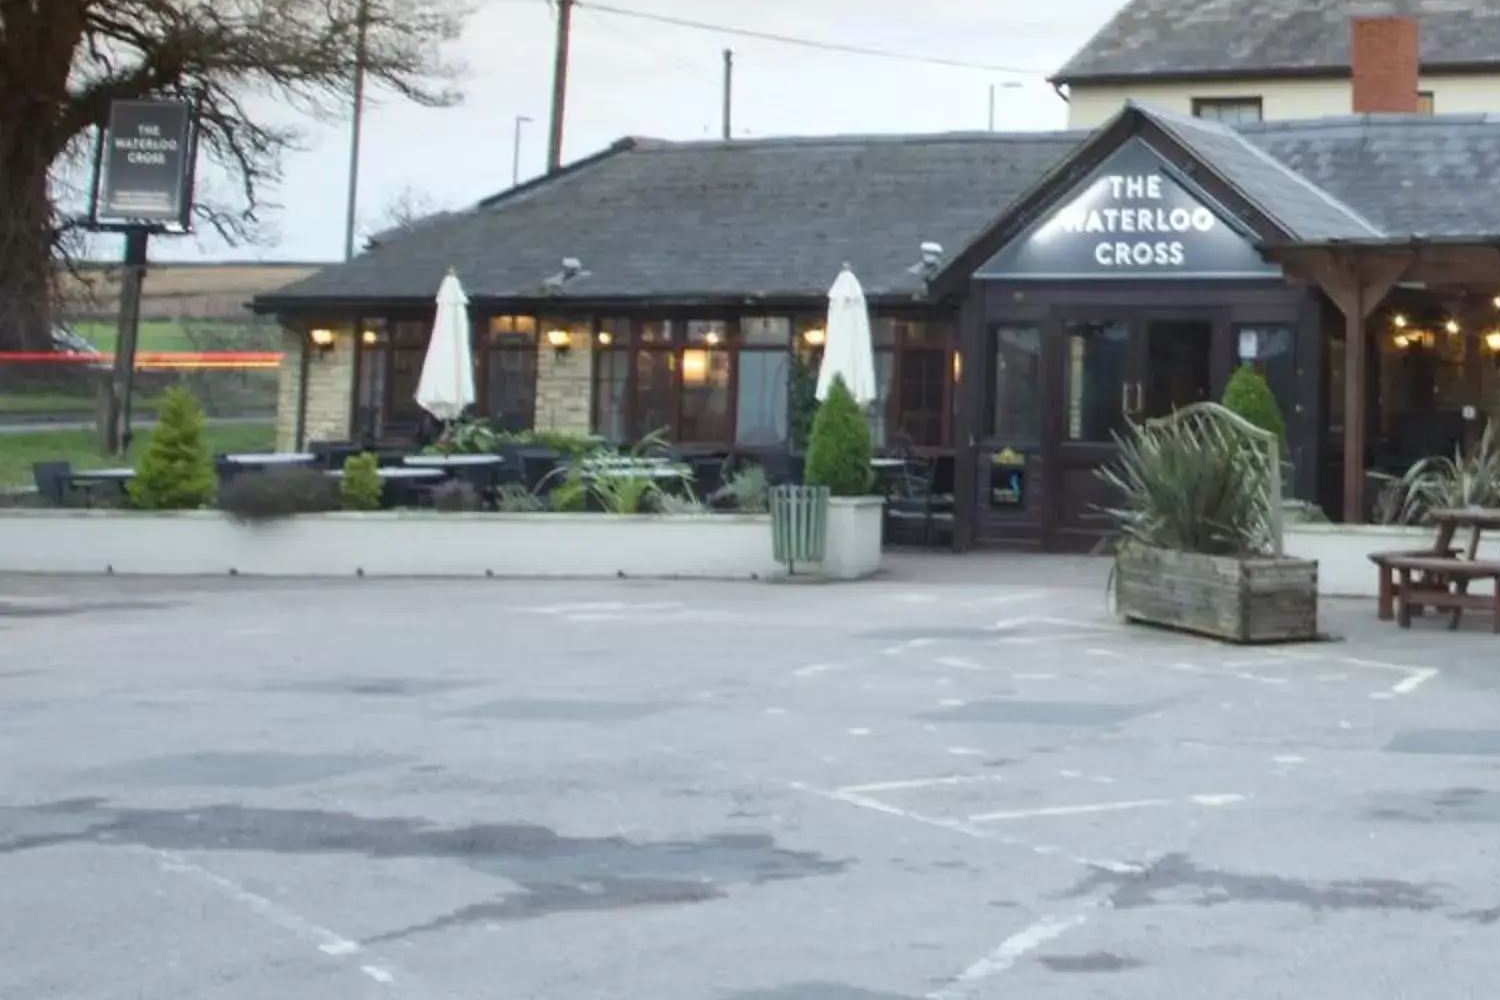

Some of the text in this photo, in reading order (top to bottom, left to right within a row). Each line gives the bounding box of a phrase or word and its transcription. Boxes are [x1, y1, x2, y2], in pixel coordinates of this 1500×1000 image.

[138, 124, 160, 136] THE
[115, 138, 177, 151] WATERLOO
[128, 152, 165, 164] CROSS
[1109, 174, 1163, 199] THE
[1095, 241, 1185, 266] CROSS
